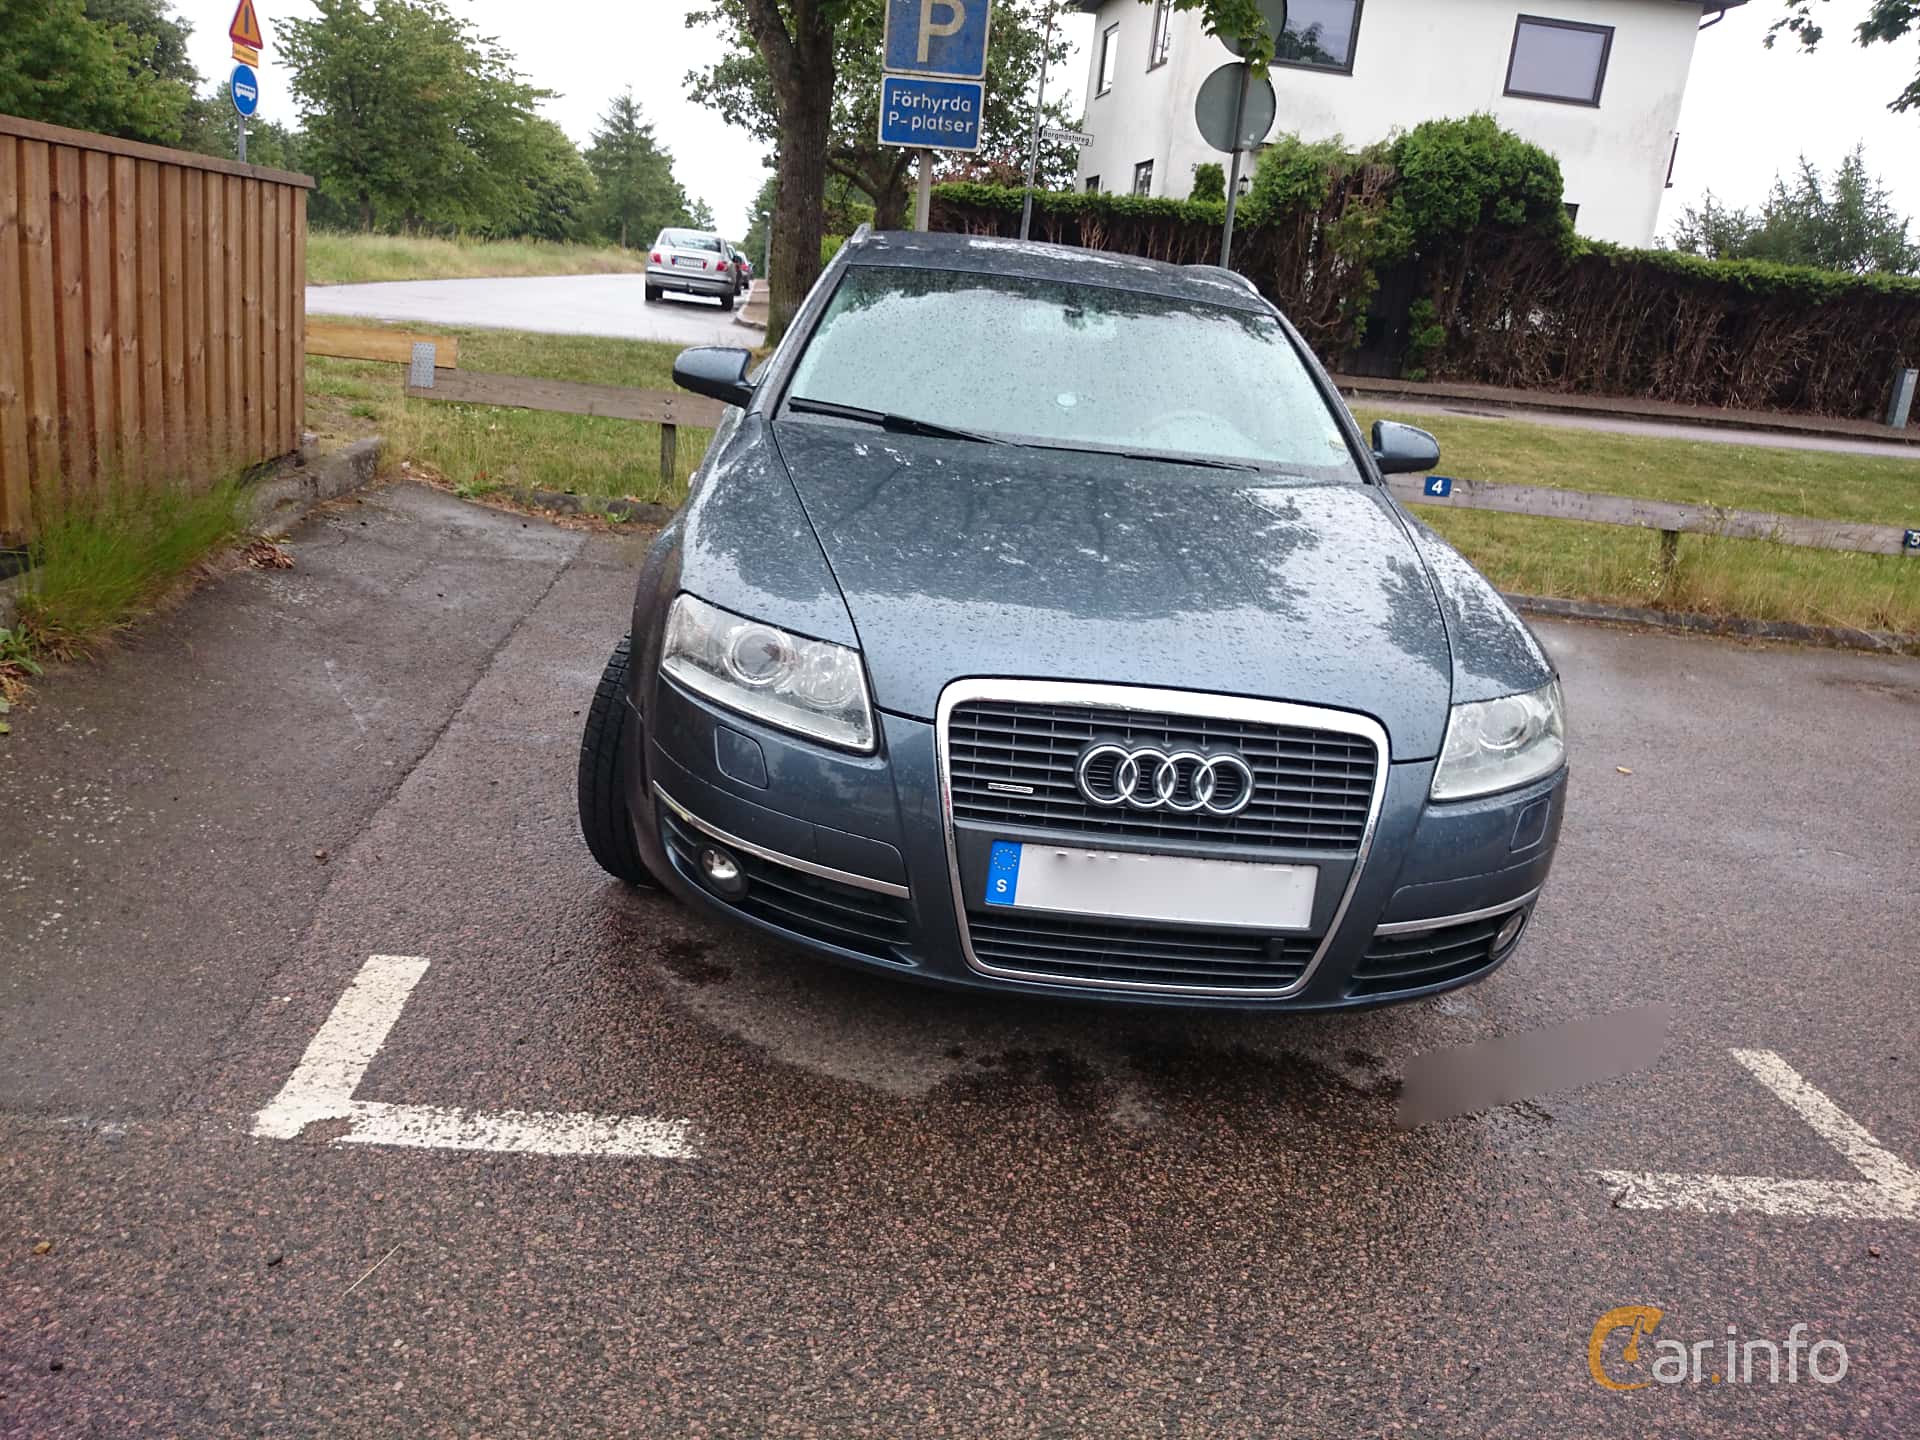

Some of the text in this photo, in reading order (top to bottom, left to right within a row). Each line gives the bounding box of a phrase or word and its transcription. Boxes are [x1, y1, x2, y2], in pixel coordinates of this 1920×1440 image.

[917, 0, 965, 62] P
[892, 90, 971, 114] Förhyrda
[1431, 479, 1443, 494] 4
[996, 879, 1008, 893] S
